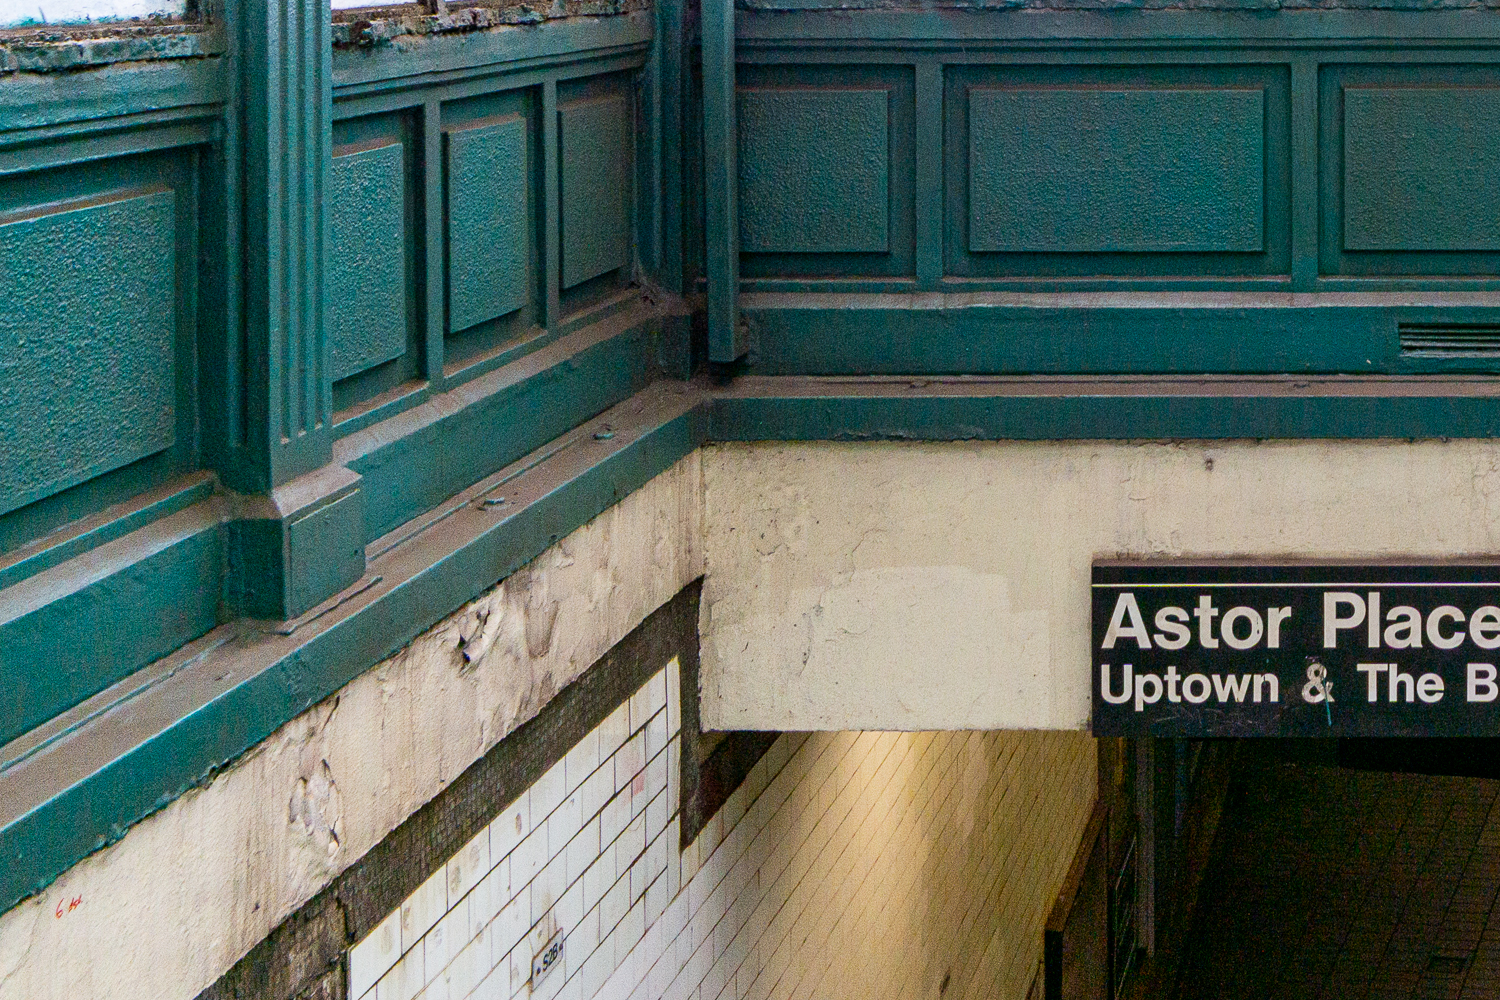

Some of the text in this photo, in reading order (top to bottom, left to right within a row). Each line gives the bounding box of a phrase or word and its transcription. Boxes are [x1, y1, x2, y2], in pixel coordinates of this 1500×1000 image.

[1101, 592, 1292, 650] Astor
[1100, 664, 1279, 712] Uptown
[1301, 663, 1335, 704] &
[1356, 663, 1445, 704] The
